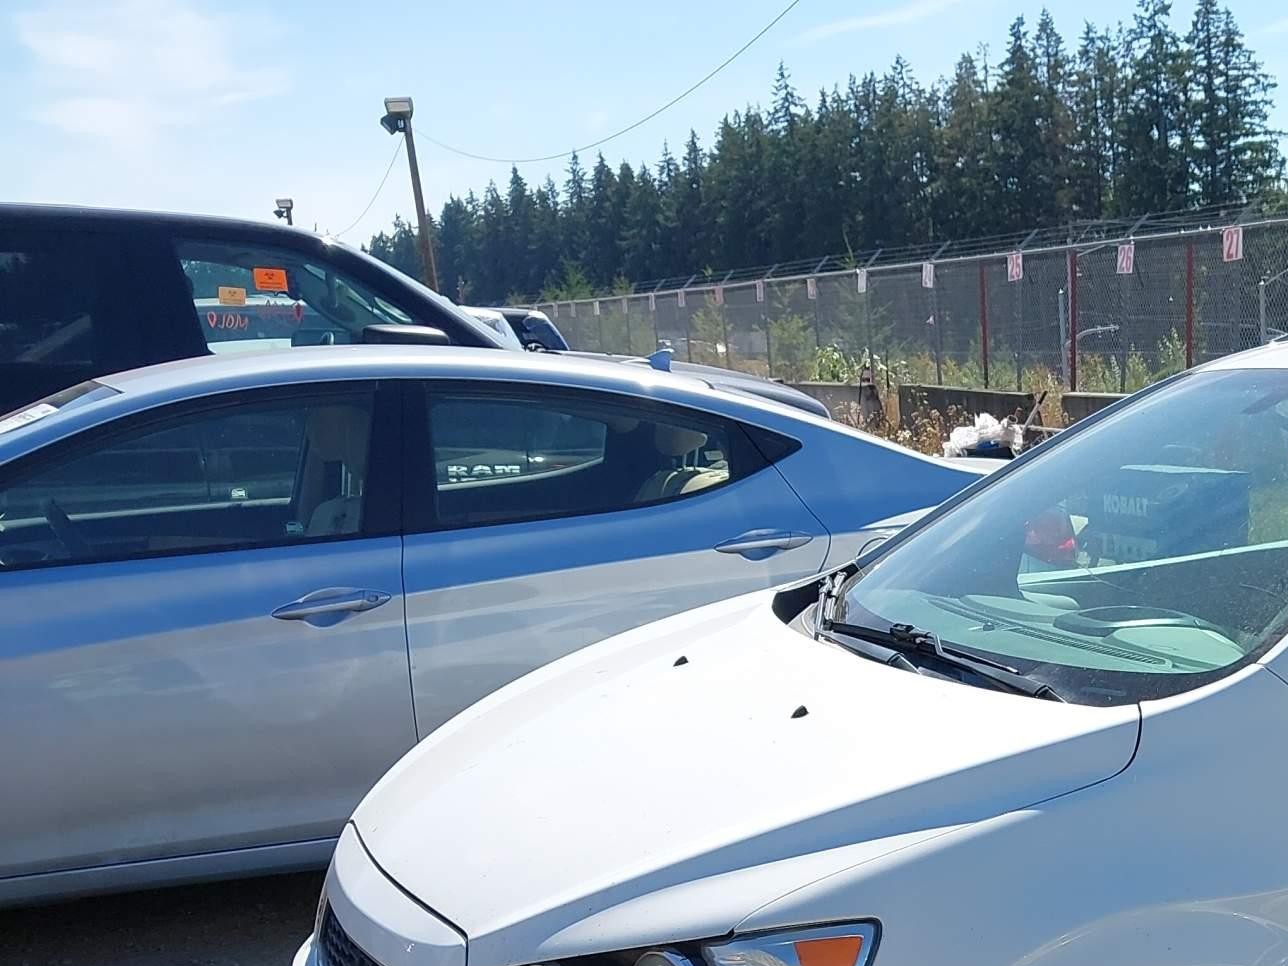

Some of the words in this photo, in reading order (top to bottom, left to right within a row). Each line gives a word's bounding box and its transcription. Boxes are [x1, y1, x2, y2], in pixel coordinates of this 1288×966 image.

[1226, 230, 1240, 259] 27
[1009, 254, 1020, 279] 25
[1119, 246, 1132, 272] 26
[447, 465, 520, 477] RAM
[1103, 494, 1149, 514] KOBALT
